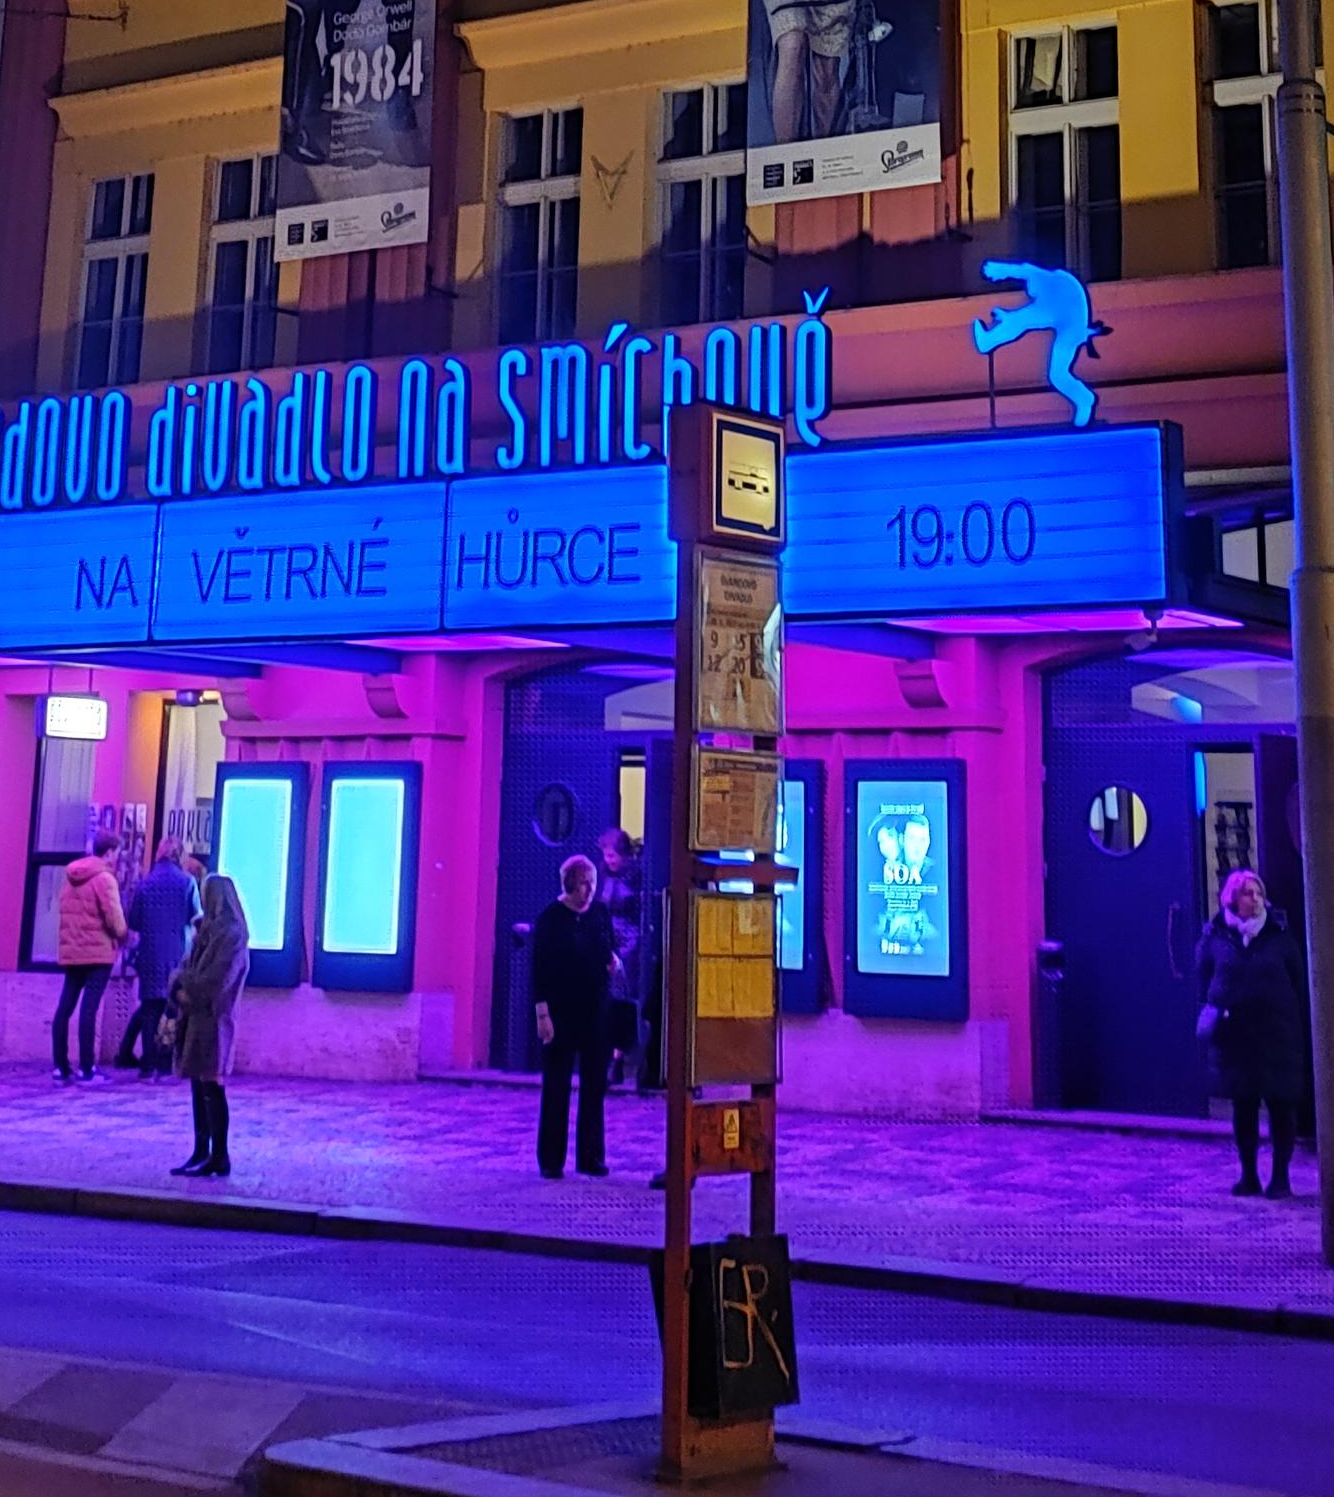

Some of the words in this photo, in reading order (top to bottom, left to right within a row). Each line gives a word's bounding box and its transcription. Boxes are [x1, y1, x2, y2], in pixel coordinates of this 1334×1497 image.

[333, 6, 373, 26] George
[330, 38, 424, 110] 1984
[148, 365, 374, 497] divadlo
[398, 358, 467, 479] na
[74, 556, 139, 610] NA
[191, 517, 389, 606] VĚTRNÉ
[454, 507, 643, 591] HŮRCE
[886, 498, 1038, 572] 19:00
[711, 631, 719, 648] 9
[731, 656, 746, 674] 20
